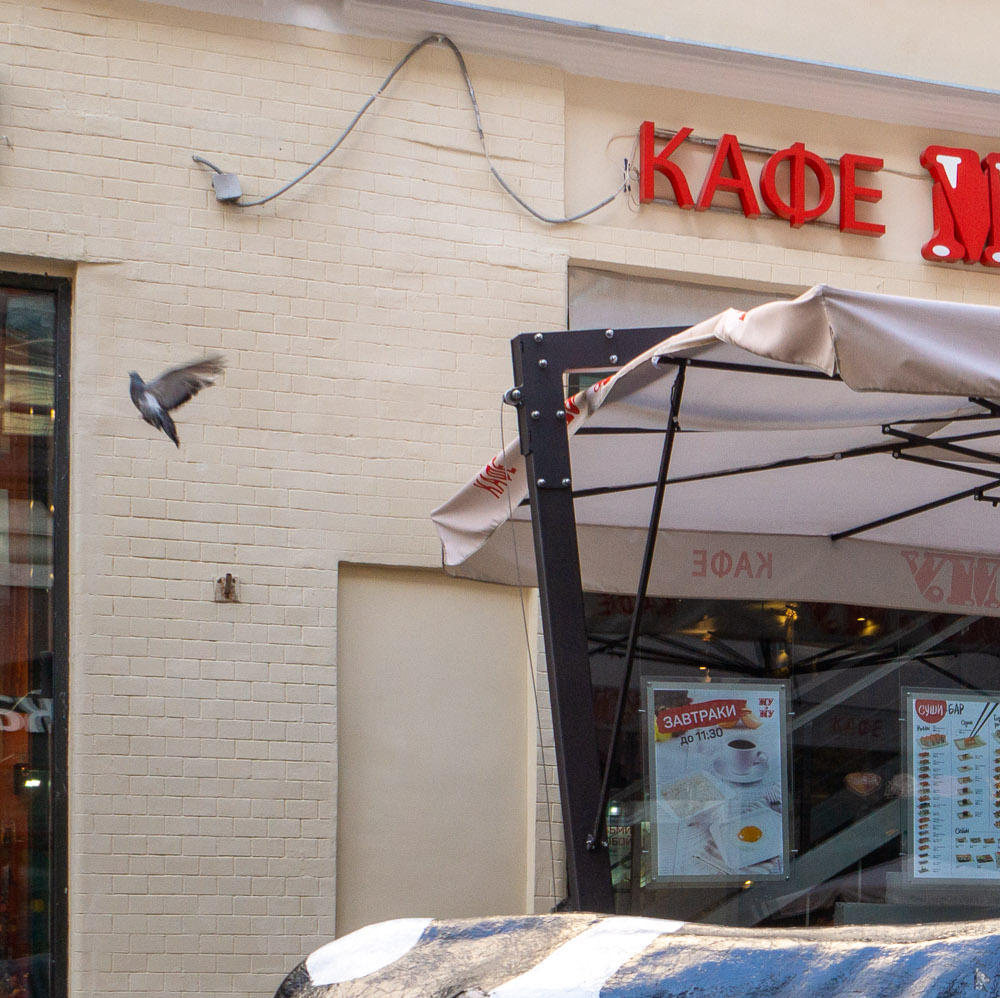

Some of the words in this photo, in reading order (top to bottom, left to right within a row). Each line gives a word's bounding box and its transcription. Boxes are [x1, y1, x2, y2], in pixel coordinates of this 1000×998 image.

[639, 120, 886, 237] КАФЕ
[663, 704, 737, 729] ЗАВТРАКИ
[948, 703, 965, 715] БАР
[681, 736, 694, 747] до
[695, 727, 724, 742] 11:30
